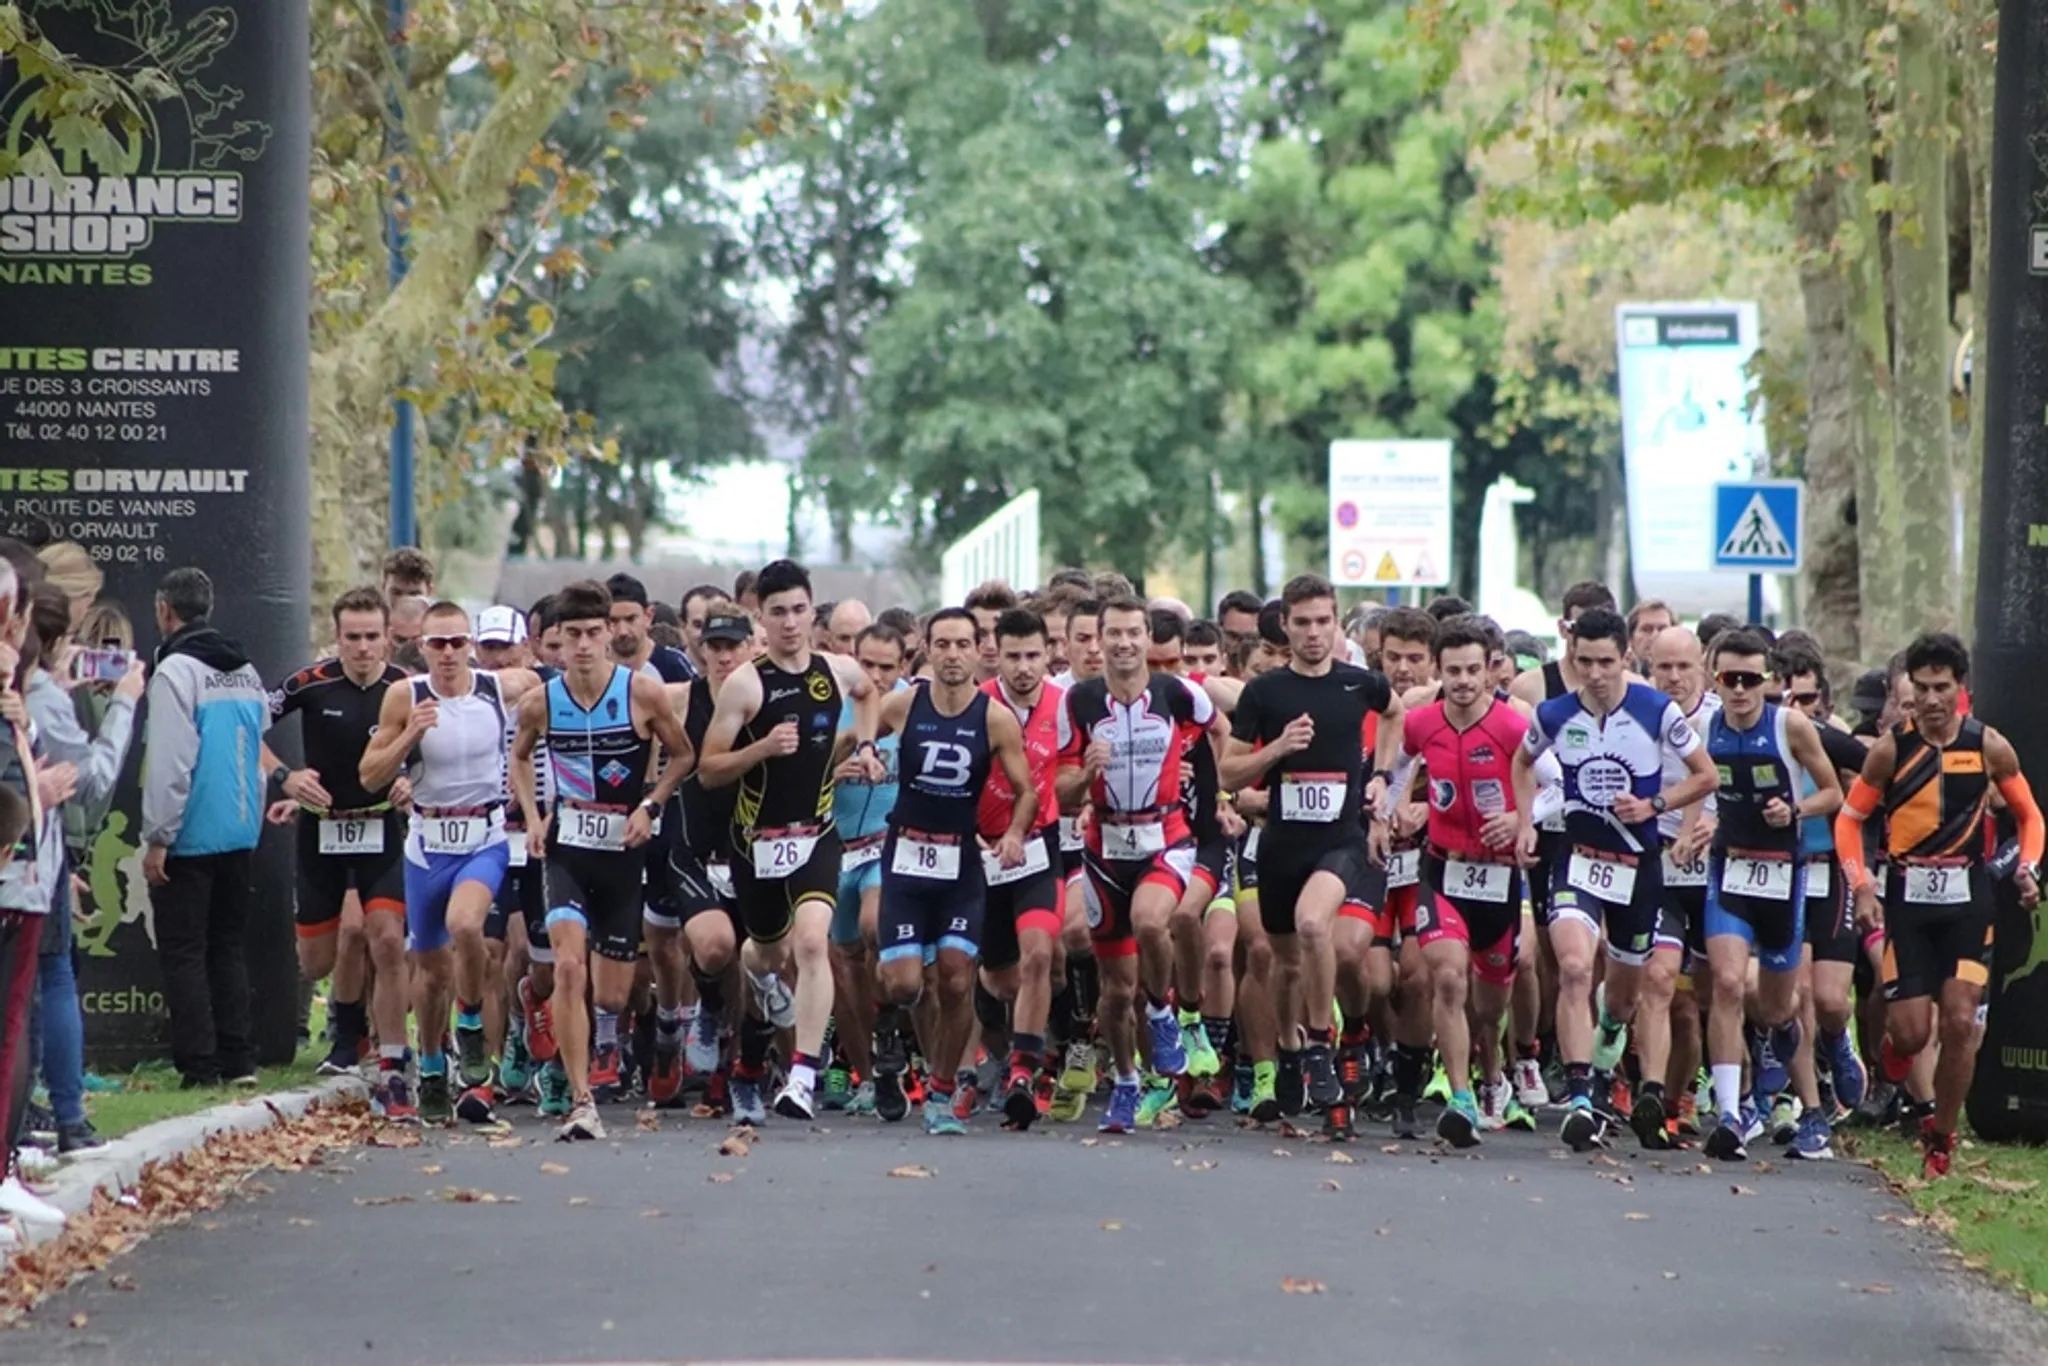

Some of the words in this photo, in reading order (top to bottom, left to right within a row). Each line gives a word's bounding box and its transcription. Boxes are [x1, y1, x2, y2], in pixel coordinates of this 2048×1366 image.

[1, 216, 147, 253] SHOP
[0, 348, 87, 370] TES
[92, 348, 241, 372] CENTRE
[26, 379, 64, 394] DES
[70, 380, 83, 394] 3
[88, 379, 212, 396] CROISSANTS
[15, 402, 71, 418] 44000
[77, 402, 157, 419] NANTES
[39, 424, 64, 440] 02
[67, 424, 89, 440] 40
[95, 425, 115, 441] 12
[121, 425, 143, 441] 00
[147, 425, 168, 441] 21
[74, 469, 249, 492] ORVAULT
[15, 500, 81, 515] ROUTE
[88, 500, 114, 515] DE
[121, 500, 197, 516] VANNES
[70, 523, 158, 538] ORVAULT
[92, 546, 113, 562] 59
[117, 546, 139, 562] 02
[145, 546, 165, 562] 16
[1297, 786, 1330, 809] 106
[336, 821, 366, 843] 167
[439, 821, 469, 843] 107
[576, 812, 609, 838] 150
[1125, 828, 1137, 850] 4
[773, 841, 799, 866] 26
[917, 846, 937, 869] 18
[1463, 866, 1488, 889] 34
[1587, 863, 1615, 889] 66
[1746, 863, 1769, 887] 70
[1926, 870, 1949, 894] 37
[82, 985, 171, 1019] cesho
